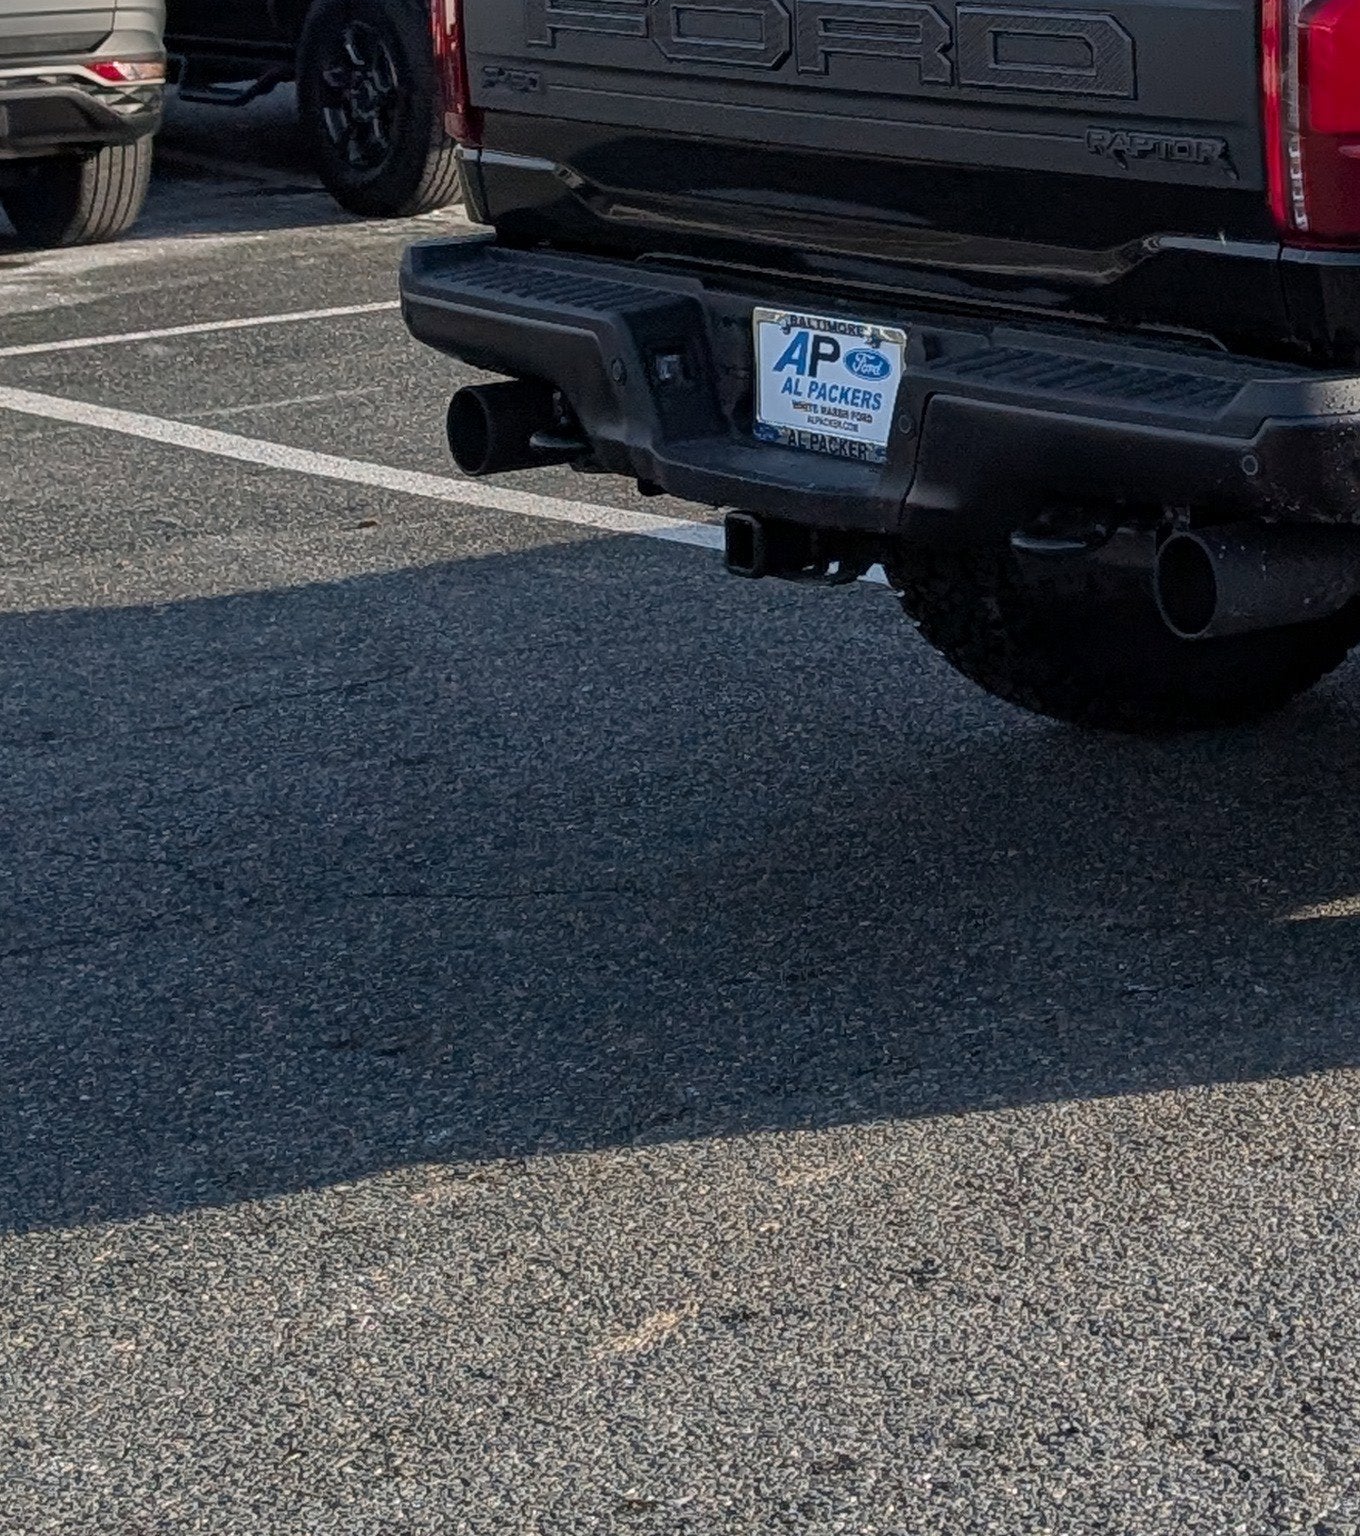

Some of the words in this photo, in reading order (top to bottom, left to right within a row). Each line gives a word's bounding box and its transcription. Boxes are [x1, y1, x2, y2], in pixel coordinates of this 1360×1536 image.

[1085, 124, 1240, 182] RAPTOR
[789, 314, 865, 338] BALTIMORE
[772, 331, 841, 378] AP
[852, 352, 884, 376] Ford
[781, 377, 803, 397] AL
[807, 381, 882, 411] PACKERS
[788, 430, 806, 449] AL
